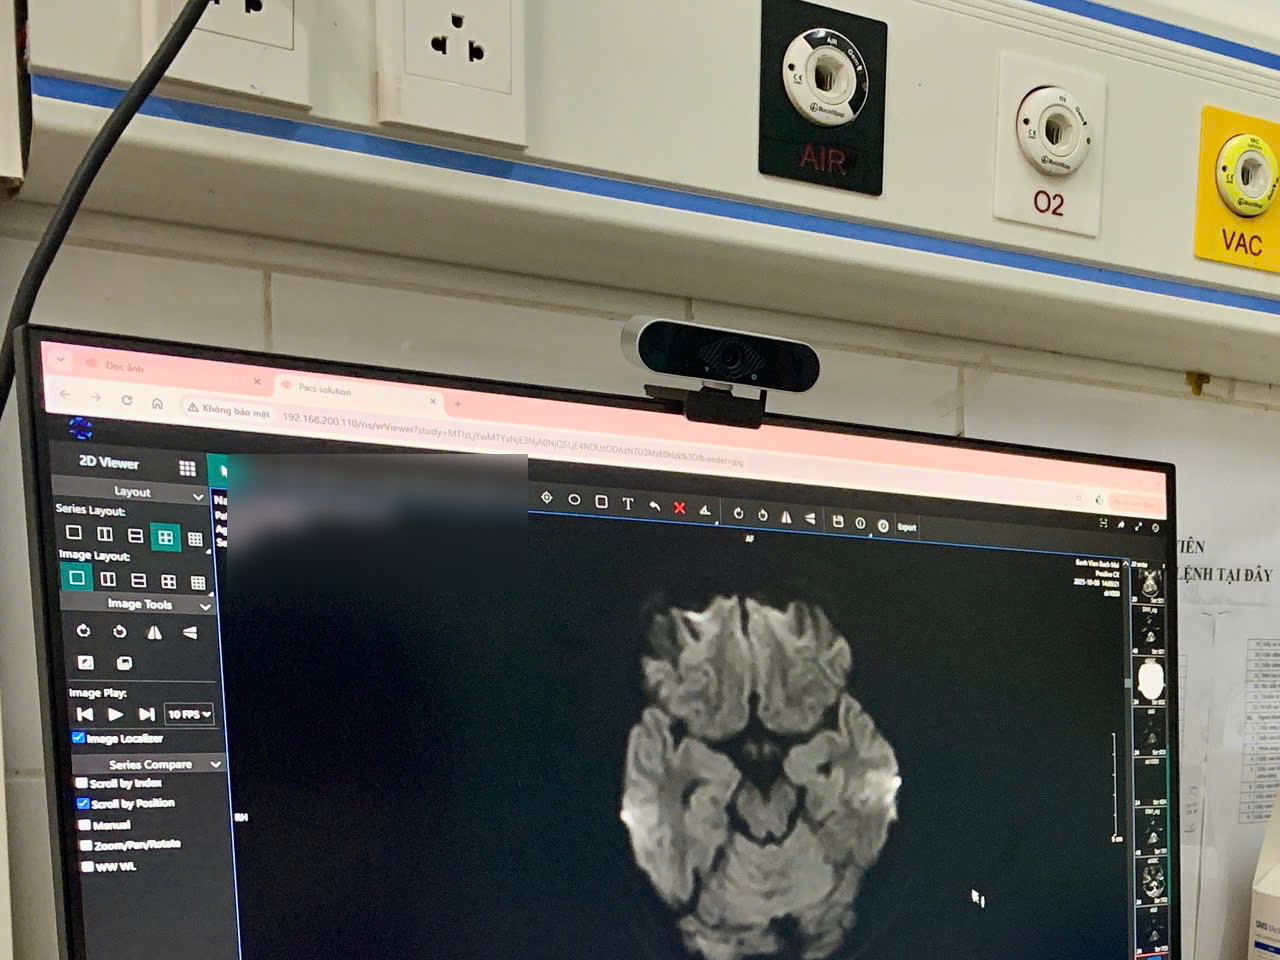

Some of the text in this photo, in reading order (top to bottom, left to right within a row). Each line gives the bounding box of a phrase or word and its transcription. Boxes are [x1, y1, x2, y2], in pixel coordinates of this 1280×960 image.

[801, 143, 846, 176] AIR
[1034, 190, 1064, 216] O2
[1222, 228, 1262, 256] VAC
[299, 383, 351, 397] Pacs solution
[203, 403, 232, 418] Không
[234, 406, 251, 417] bảo
[79, 455, 140, 471] 2D Viewer
[114, 485, 151, 499] Layout
[56, 503, 87, 514] Series
[897, 523, 917, 532] Export
[1177, 536, 1205, 554] IÊN
[59, 549, 92, 562] Image
[1216, 567, 1241, 585] TẠI
[1244, 565, 1274, 582] ĐÂY
[108, 597, 172, 611] Image Tools
[69, 688, 127, 699] Image Play:
[169, 710, 200, 719] 10 FPS
[86, 733, 164, 746] Image Localizer
[109, 760, 193, 772] Series Compare
[89, 778, 162, 790] Scroll by Index
[91, 798, 175, 811] Scroll by Position
[93, 820, 131, 830] Manual
[94, 839, 181, 852] Zoom/Pan/Rotate
[95, 862, 137, 872] WW WL
[1256, 920, 1268, 931] SMS
